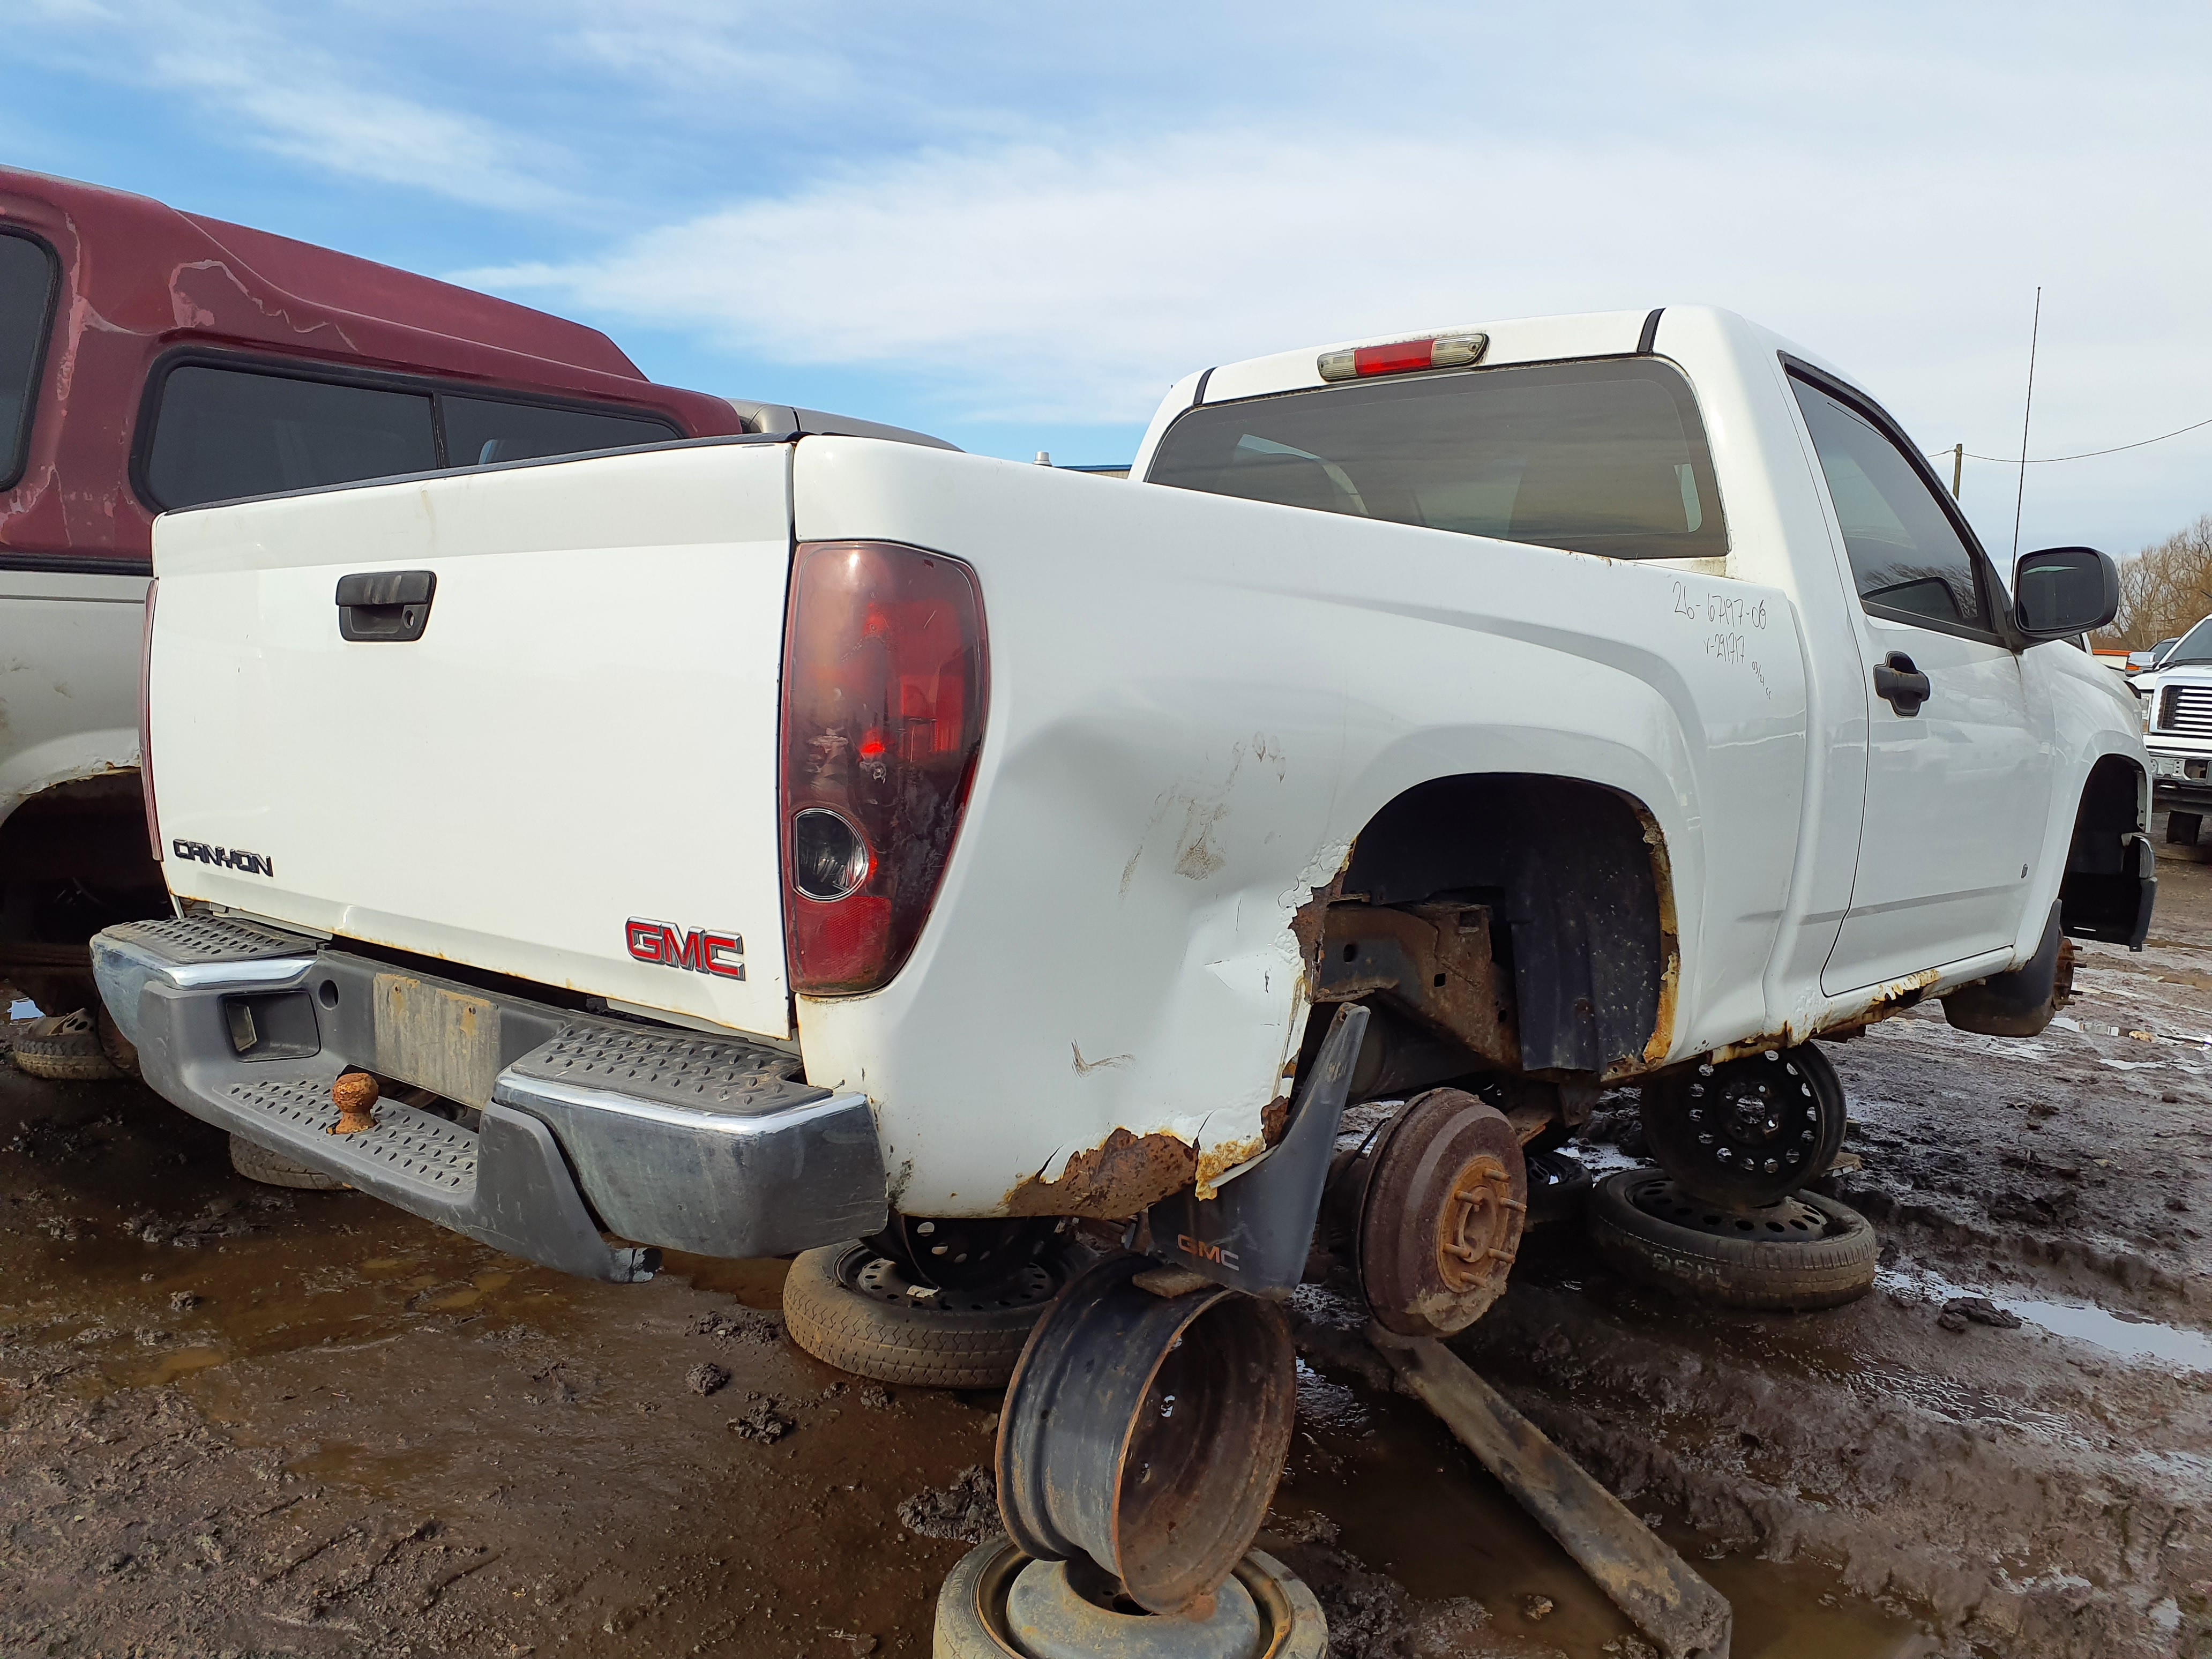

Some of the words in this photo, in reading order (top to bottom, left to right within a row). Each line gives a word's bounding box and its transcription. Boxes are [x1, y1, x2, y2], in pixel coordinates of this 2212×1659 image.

[173, 839, 273, 877] CANYON
[625, 916, 746, 981] GMC
[1177, 1234, 1239, 1271] GMC
